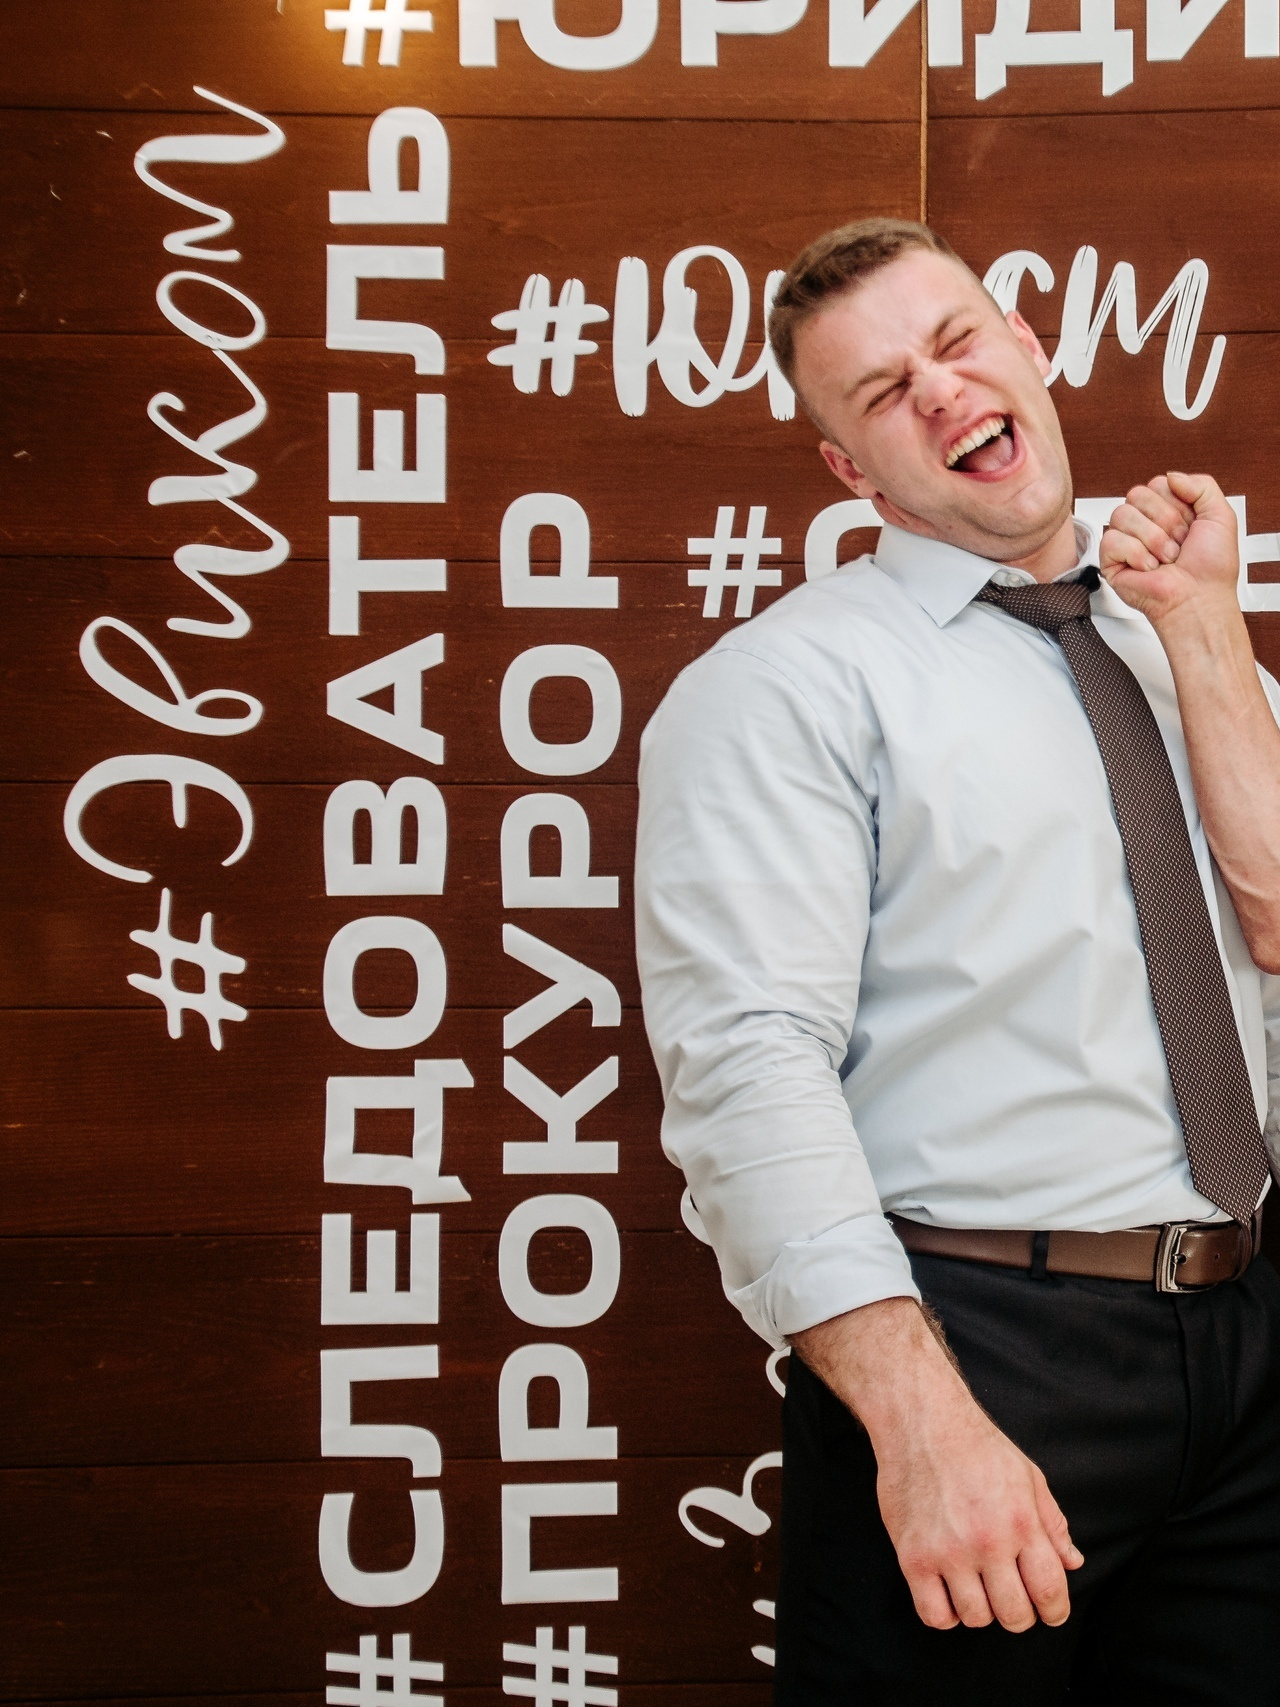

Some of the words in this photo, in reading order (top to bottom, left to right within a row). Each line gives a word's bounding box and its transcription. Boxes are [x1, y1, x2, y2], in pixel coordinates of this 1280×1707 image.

[318, 106, 475, 1707] #СЛЕДОВАТЕЛЬ
[487, 245, 1226, 421] #Юст
[498, 492, 623, 1707] #ПРОКУРОР
